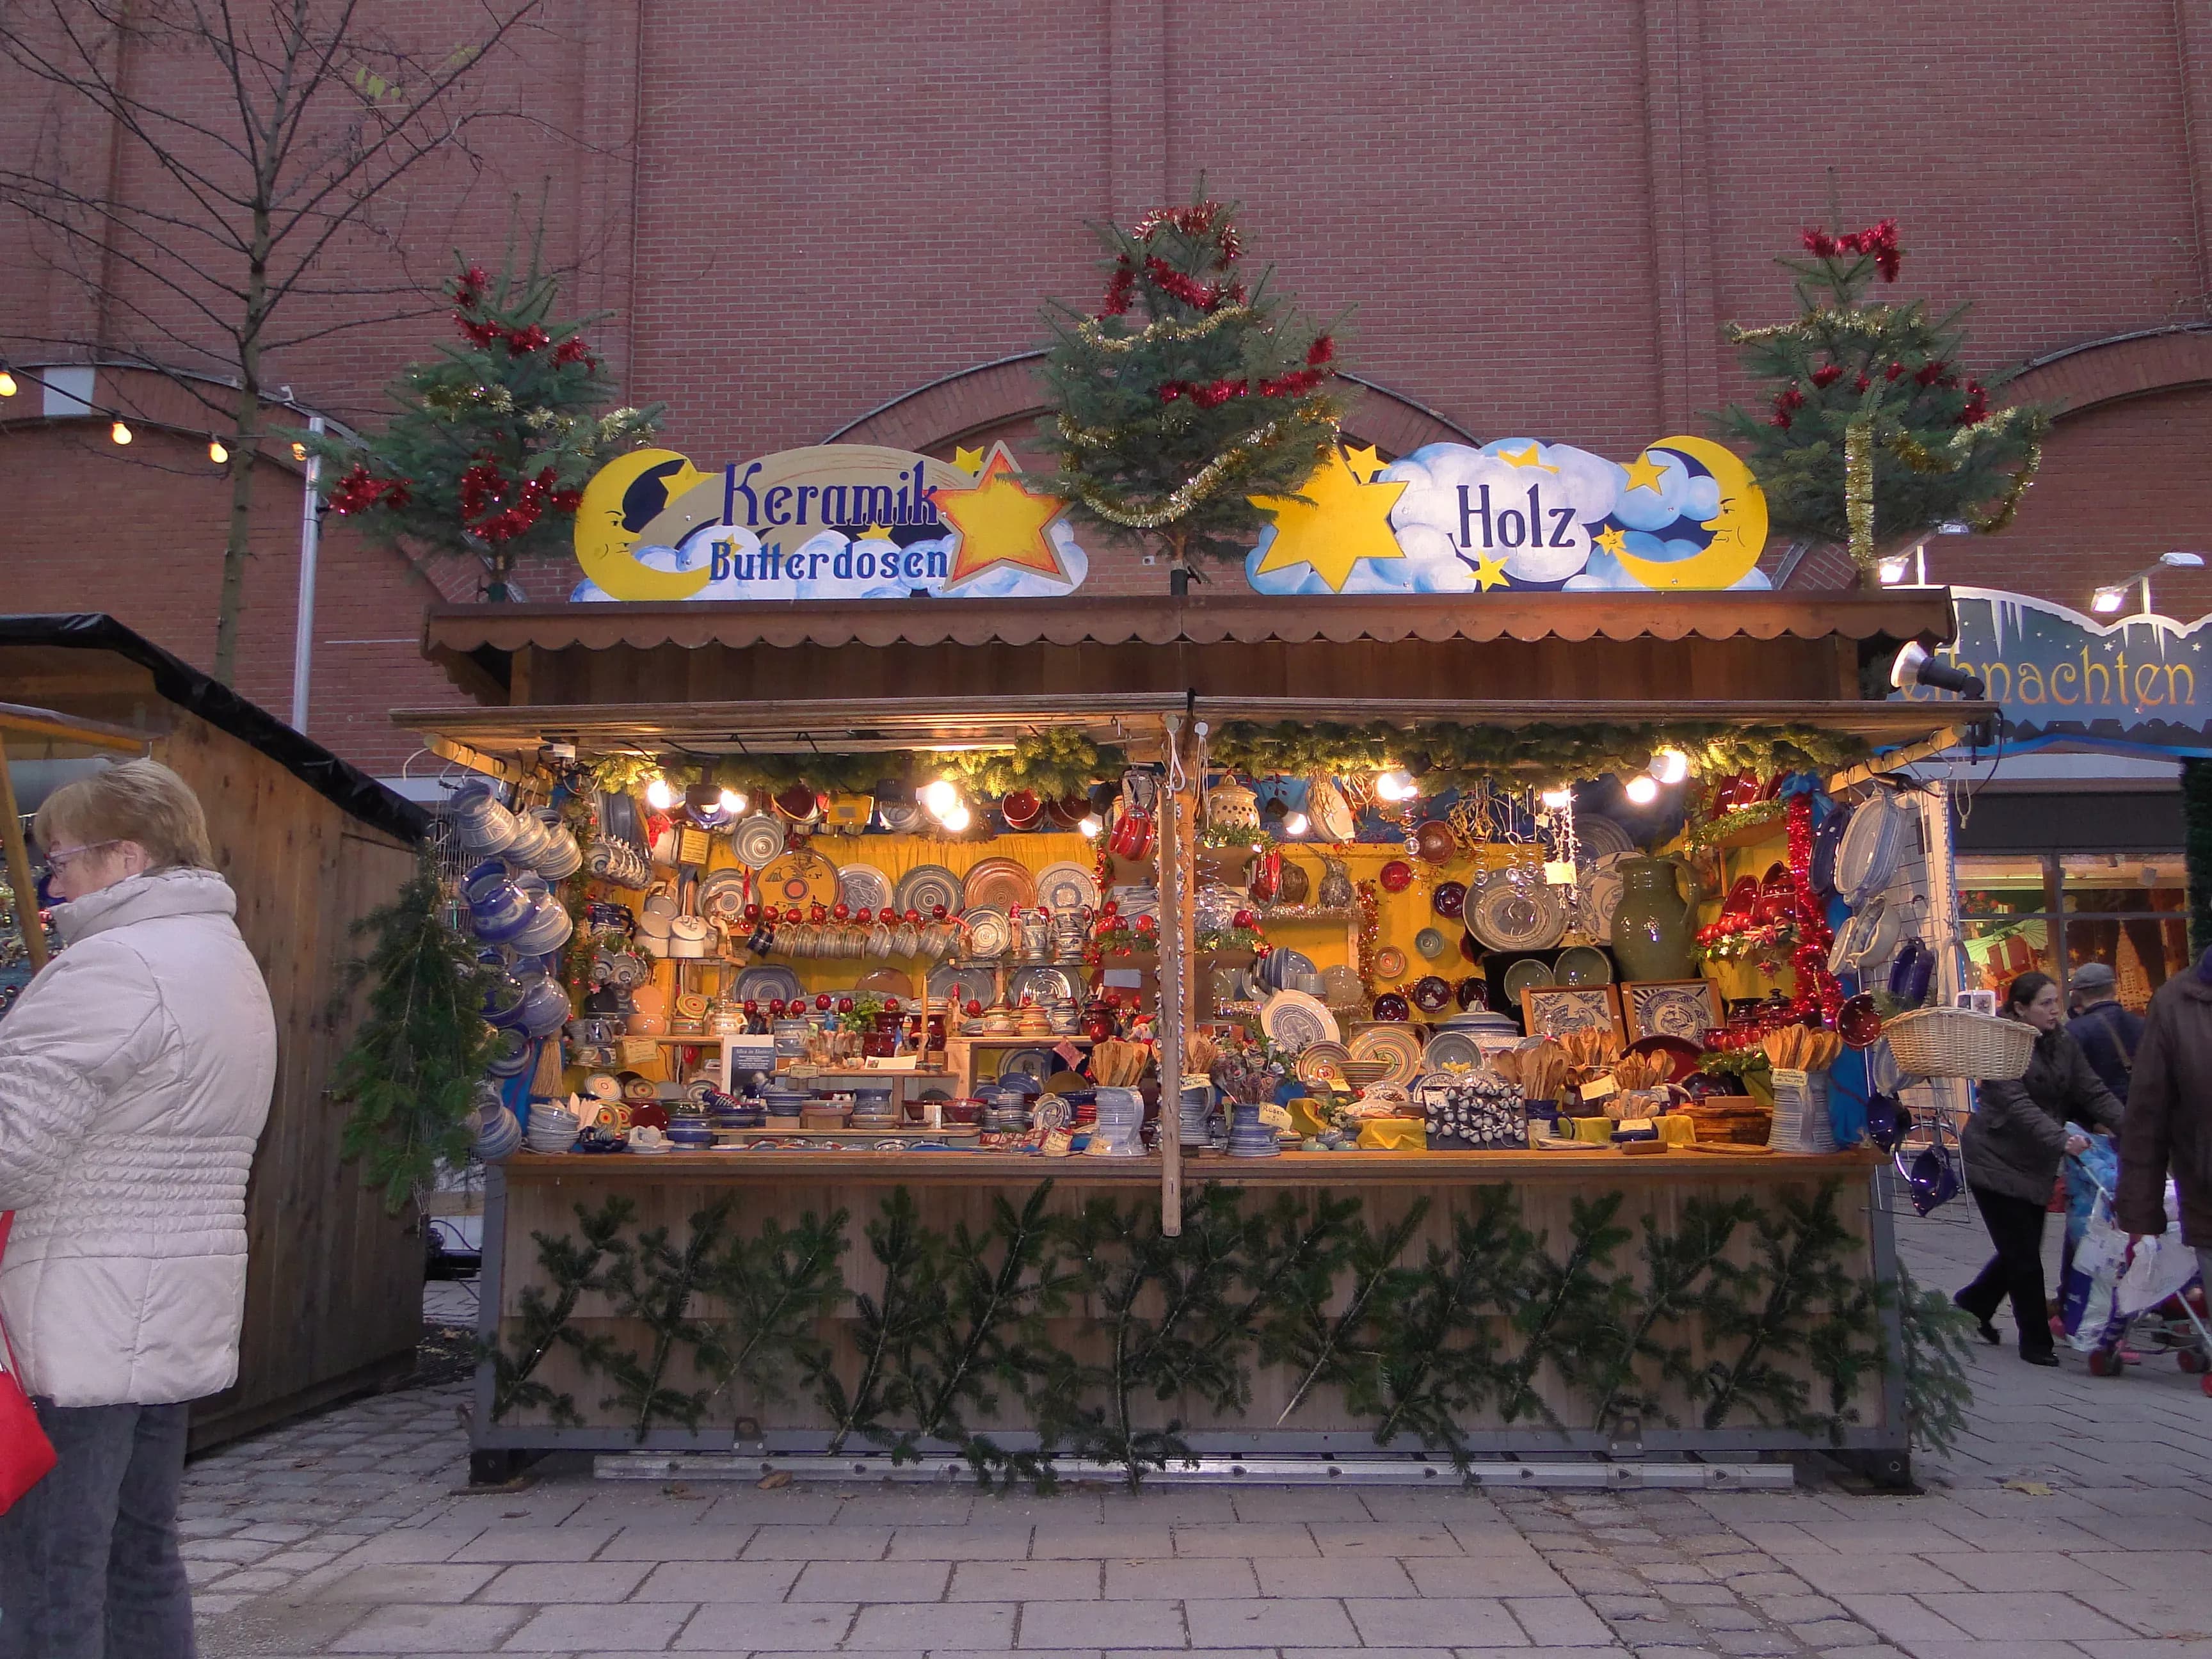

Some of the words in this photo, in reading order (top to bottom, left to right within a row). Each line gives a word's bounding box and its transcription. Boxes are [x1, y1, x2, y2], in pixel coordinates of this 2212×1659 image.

[721, 460, 939, 526] Keramik
[1456, 483, 1576, 547] Holz
[709, 541, 949, 581] Butterdosen
